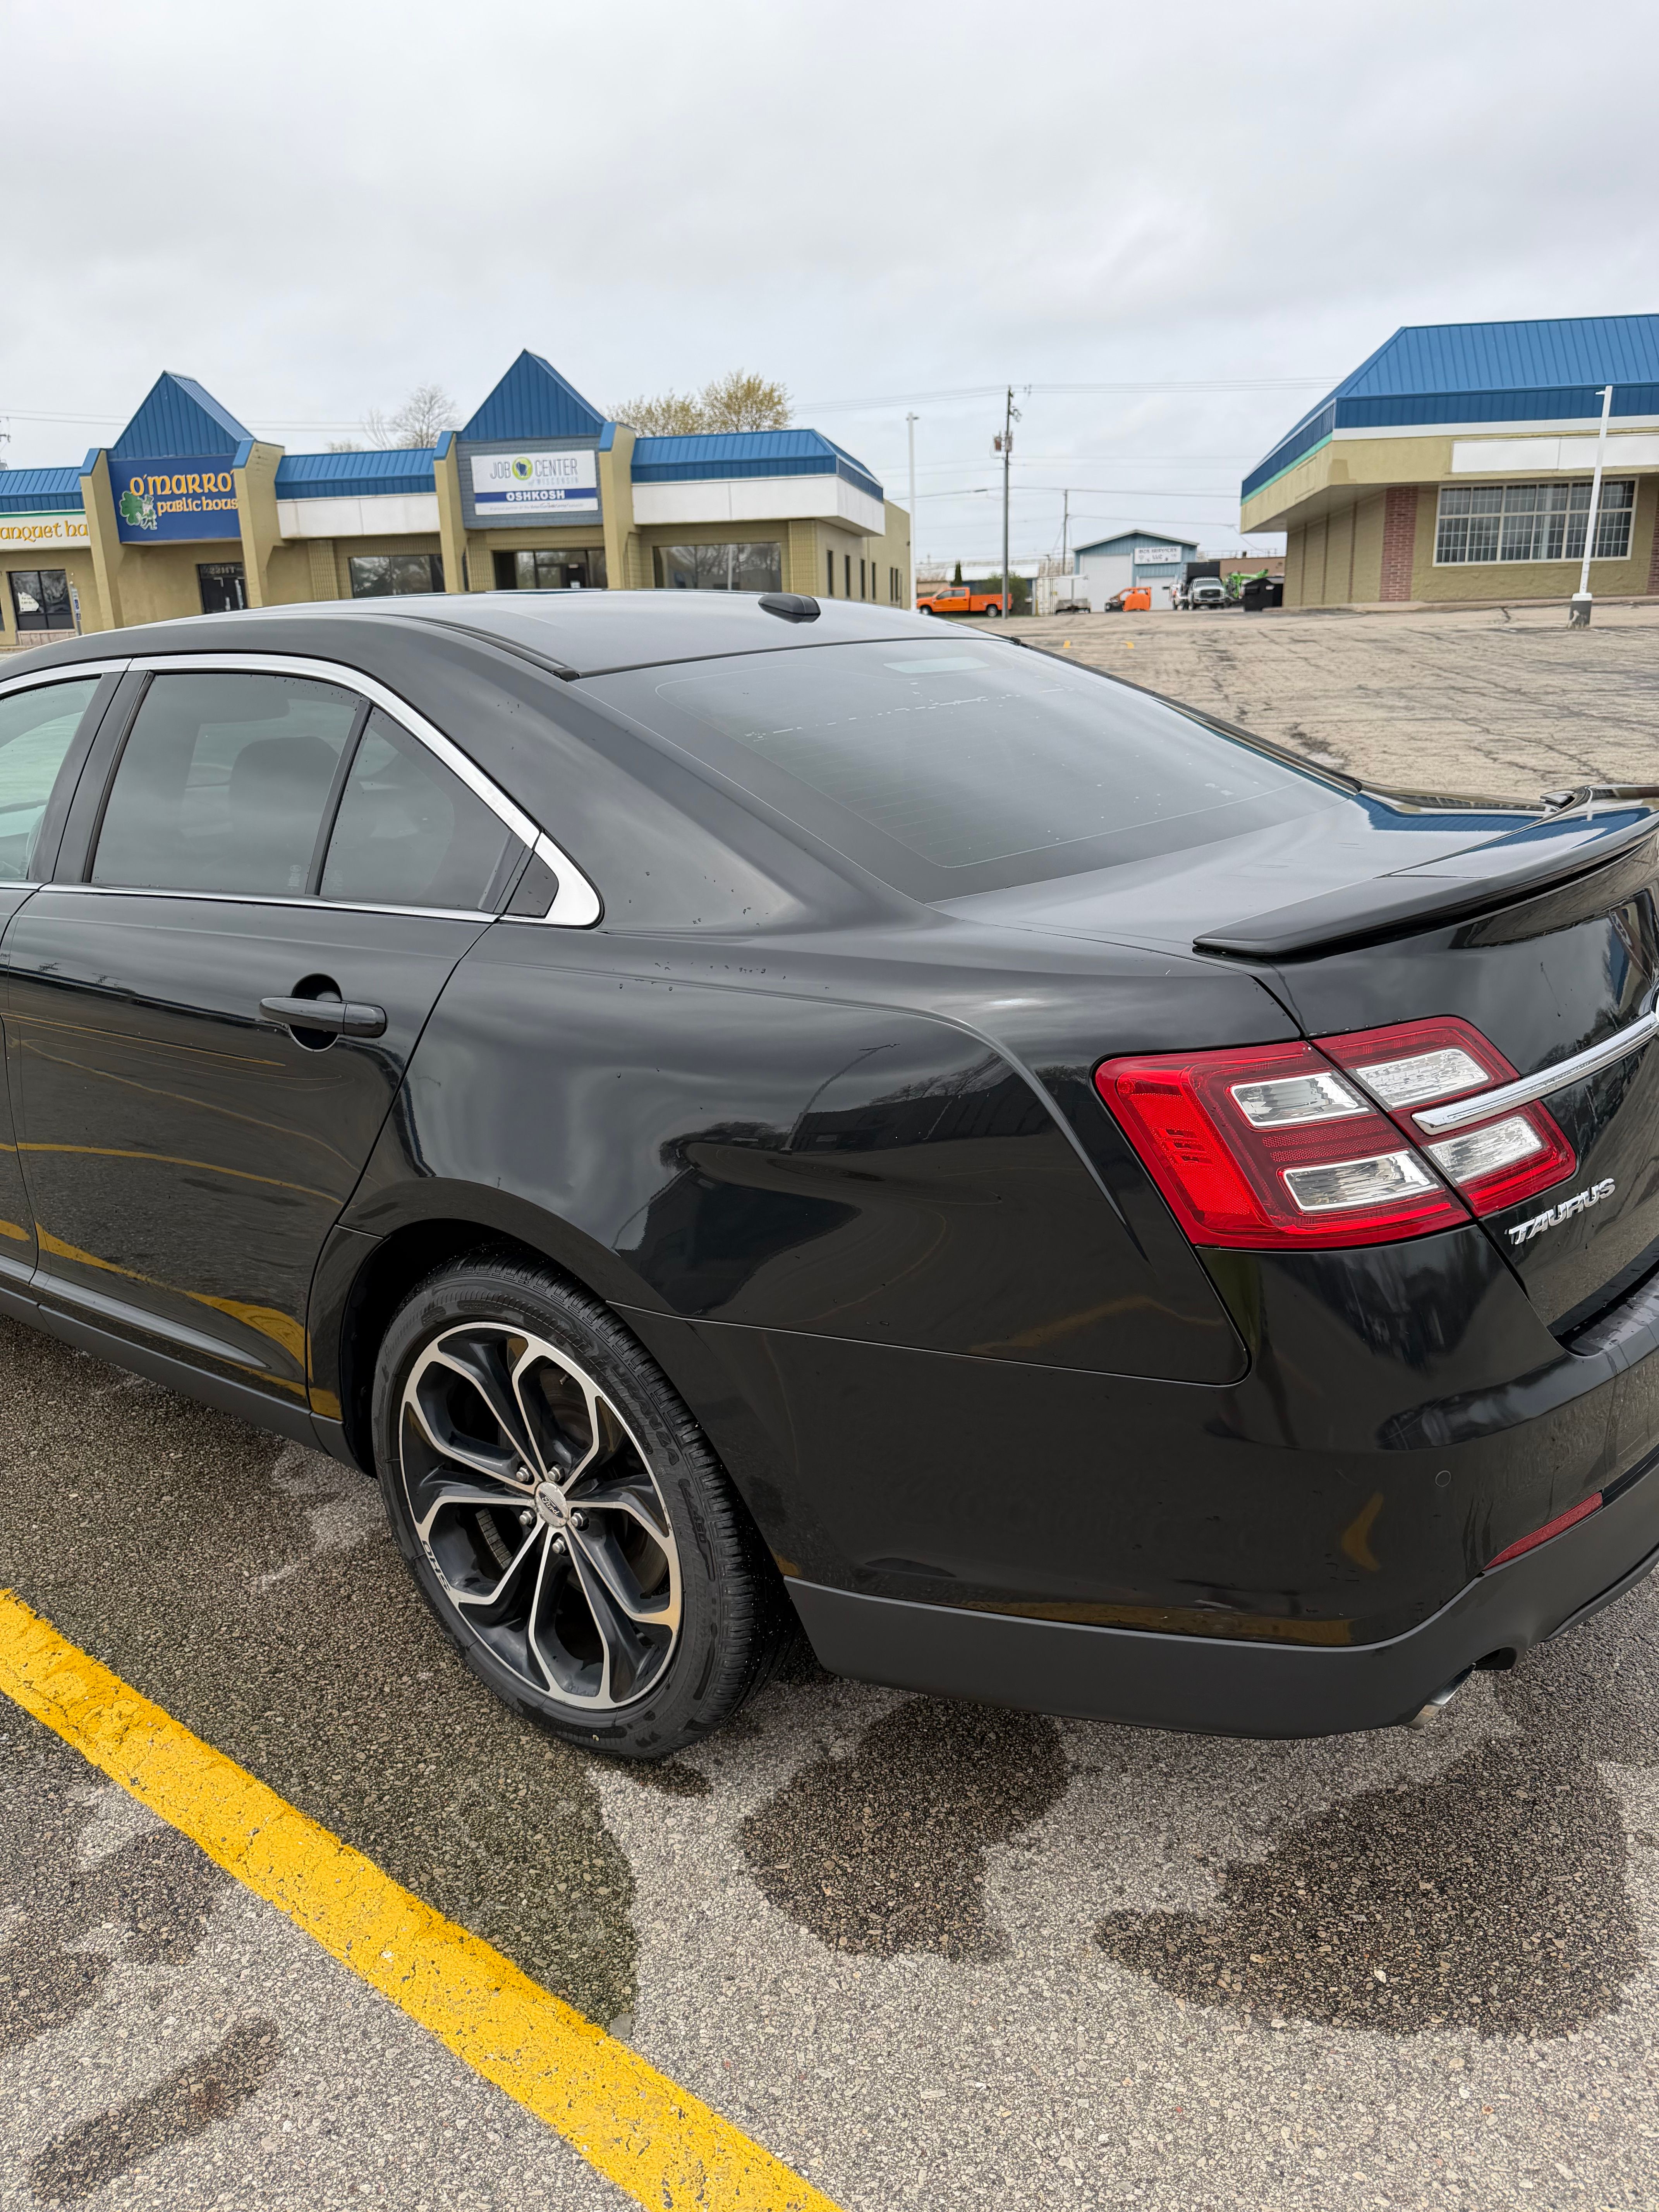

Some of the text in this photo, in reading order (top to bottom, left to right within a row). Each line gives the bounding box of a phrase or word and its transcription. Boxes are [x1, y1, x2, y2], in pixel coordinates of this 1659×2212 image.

[490, 458, 578, 479] JOB CENTER
[506, 490, 565, 501] OSHKOSH
[1504, 1178, 1615, 1245] TAURUS
[542, 1496, 559, 1516] Ford
[422, 1540, 450, 1591] SHO
